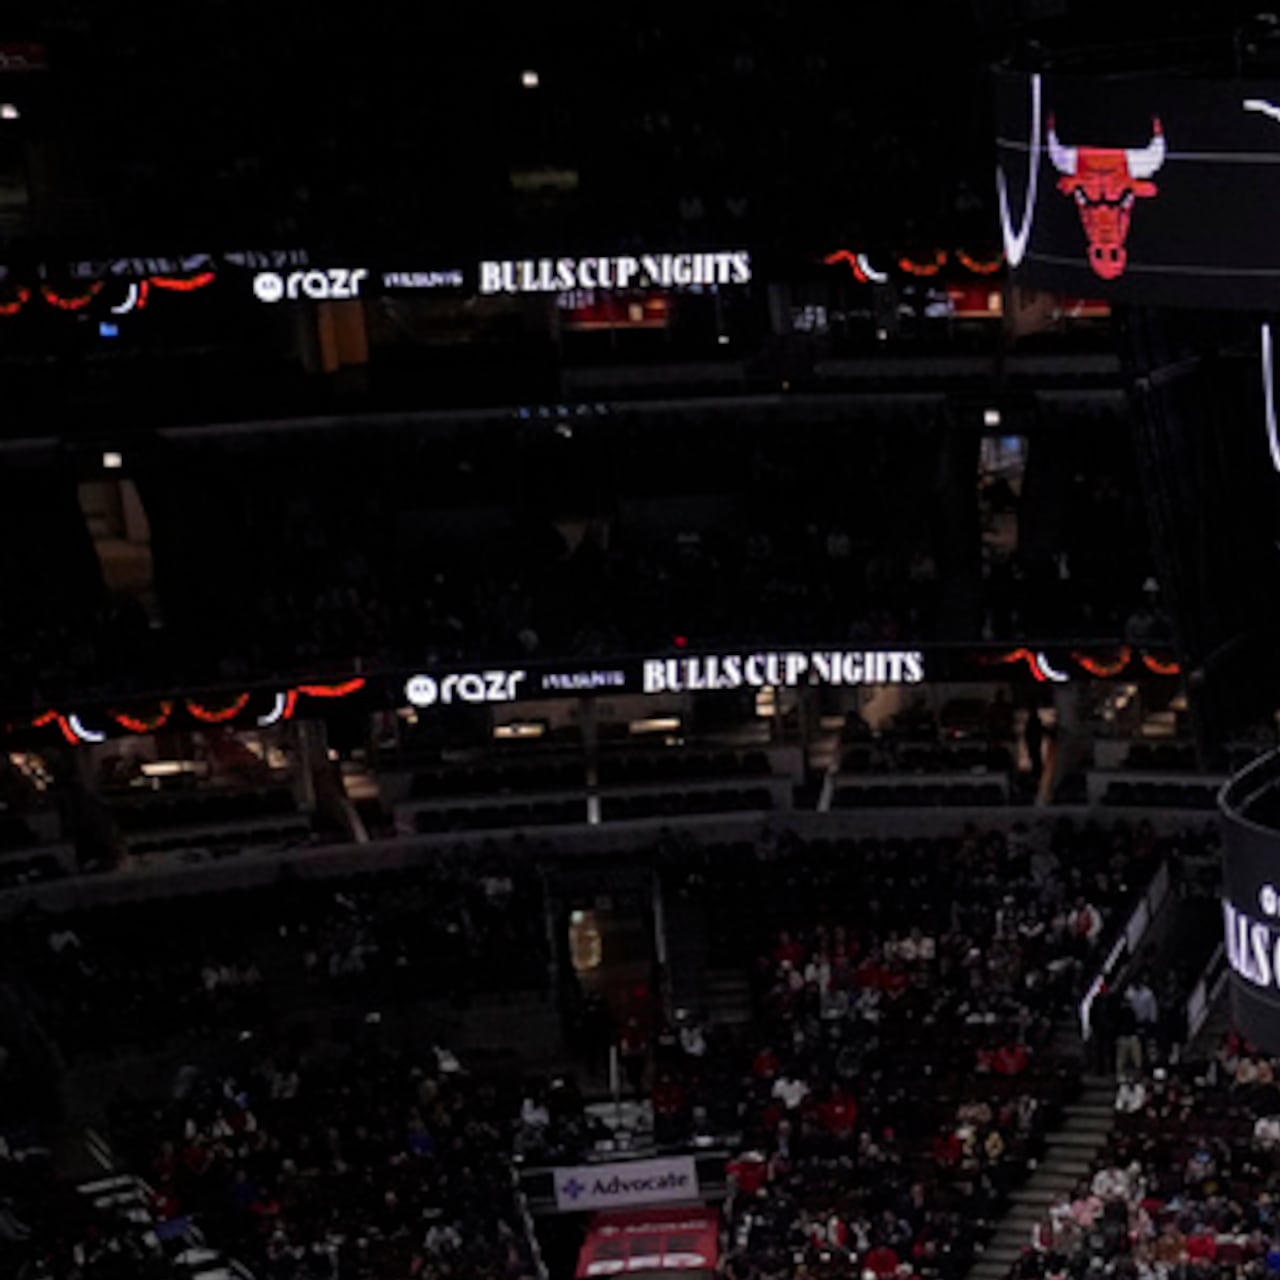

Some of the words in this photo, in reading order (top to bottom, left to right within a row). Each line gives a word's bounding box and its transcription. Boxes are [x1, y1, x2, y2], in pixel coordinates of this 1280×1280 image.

[287, 269, 367, 299] razr
[479, 259, 575, 293] BULLS
[577, 257, 638, 289] CUP
[640, 251, 751, 287] NIGHTS
[441, 671, 526, 702] razr
[643, 658, 742, 693] BULLS
[744, 656, 809, 686] CUP
[810, 652, 925, 685] NIGHTS
[591, 1173, 689, 1196] Advocate
